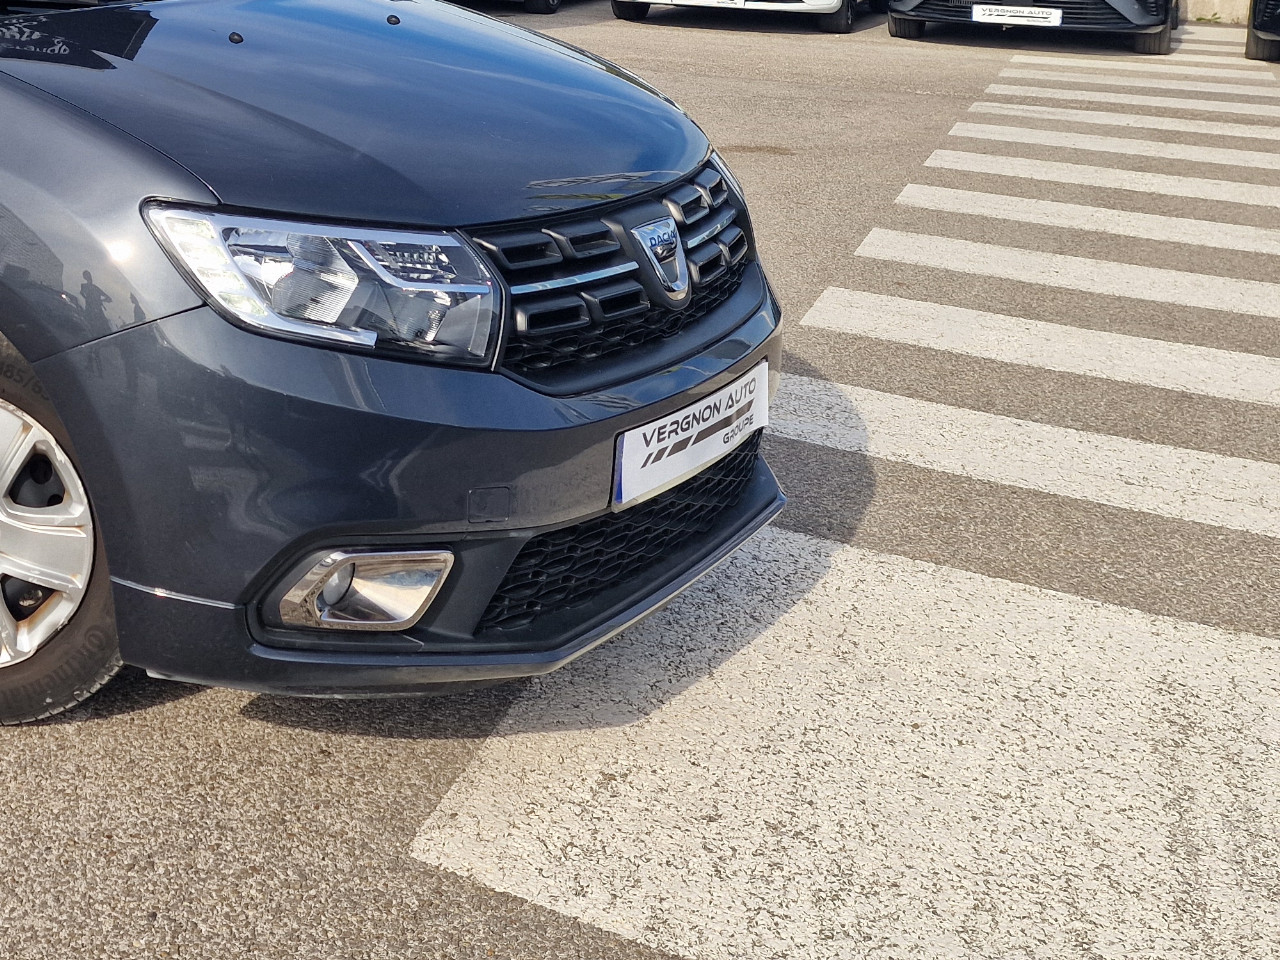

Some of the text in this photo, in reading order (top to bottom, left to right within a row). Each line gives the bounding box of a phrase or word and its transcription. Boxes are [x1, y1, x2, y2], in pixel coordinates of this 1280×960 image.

[641, 376, 757, 448] VERGNON AUTO
[722, 413, 755, 445] GROUPE
